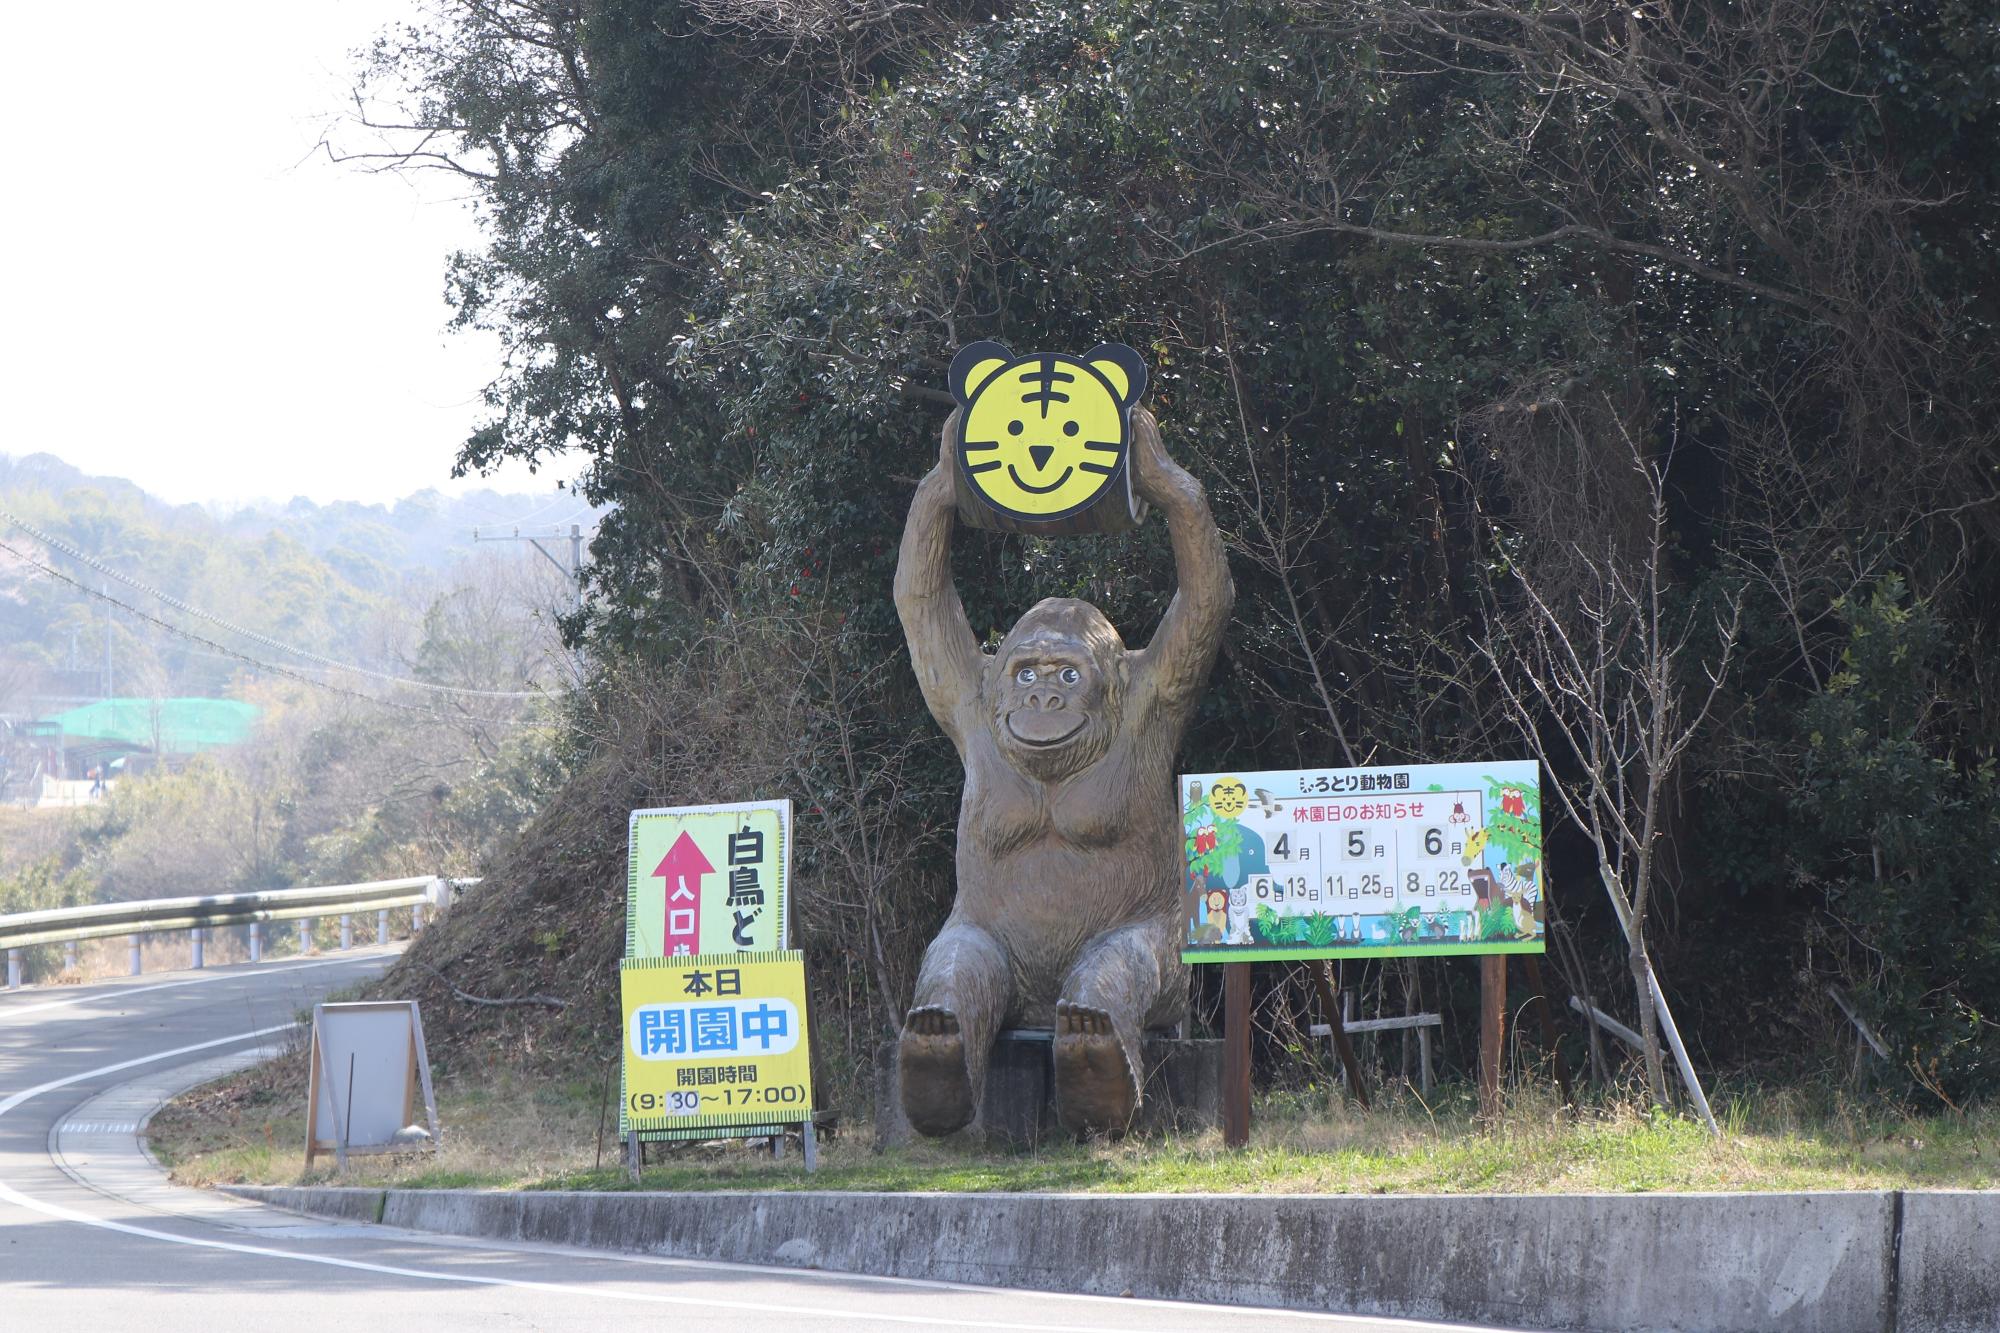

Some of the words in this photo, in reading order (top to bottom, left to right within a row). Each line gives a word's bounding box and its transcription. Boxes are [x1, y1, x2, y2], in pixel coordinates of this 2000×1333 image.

[1299, 773, 1410, 794] しろとり動物園
[1293, 802, 1425, 823] 休園日のお知らせ
[726, 825, 765, 952] 白鳥ど
[682, 969, 742, 998] 本日
[639, 1003, 788, 1056] 開園中
[676, 1065, 758, 1087] 開園時間
